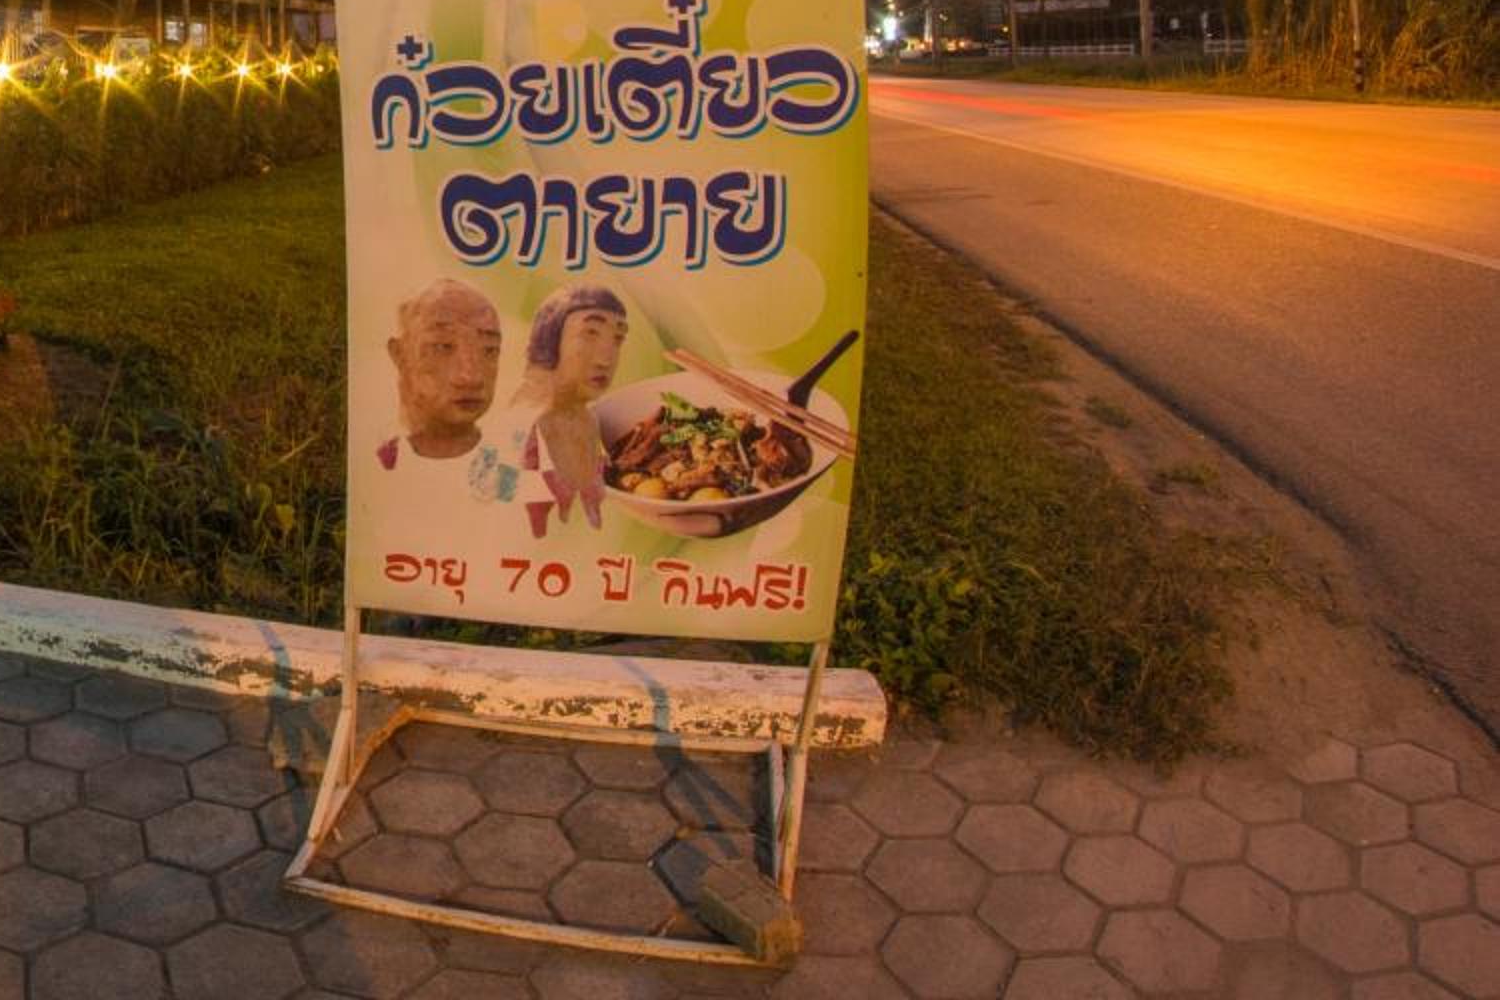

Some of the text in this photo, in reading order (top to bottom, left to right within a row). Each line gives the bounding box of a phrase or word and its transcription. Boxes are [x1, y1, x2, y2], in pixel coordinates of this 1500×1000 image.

[440, 171, 788, 268] ตายาย
[384, 553, 807, 611] อายุ 70 ปี กินฟรี!
